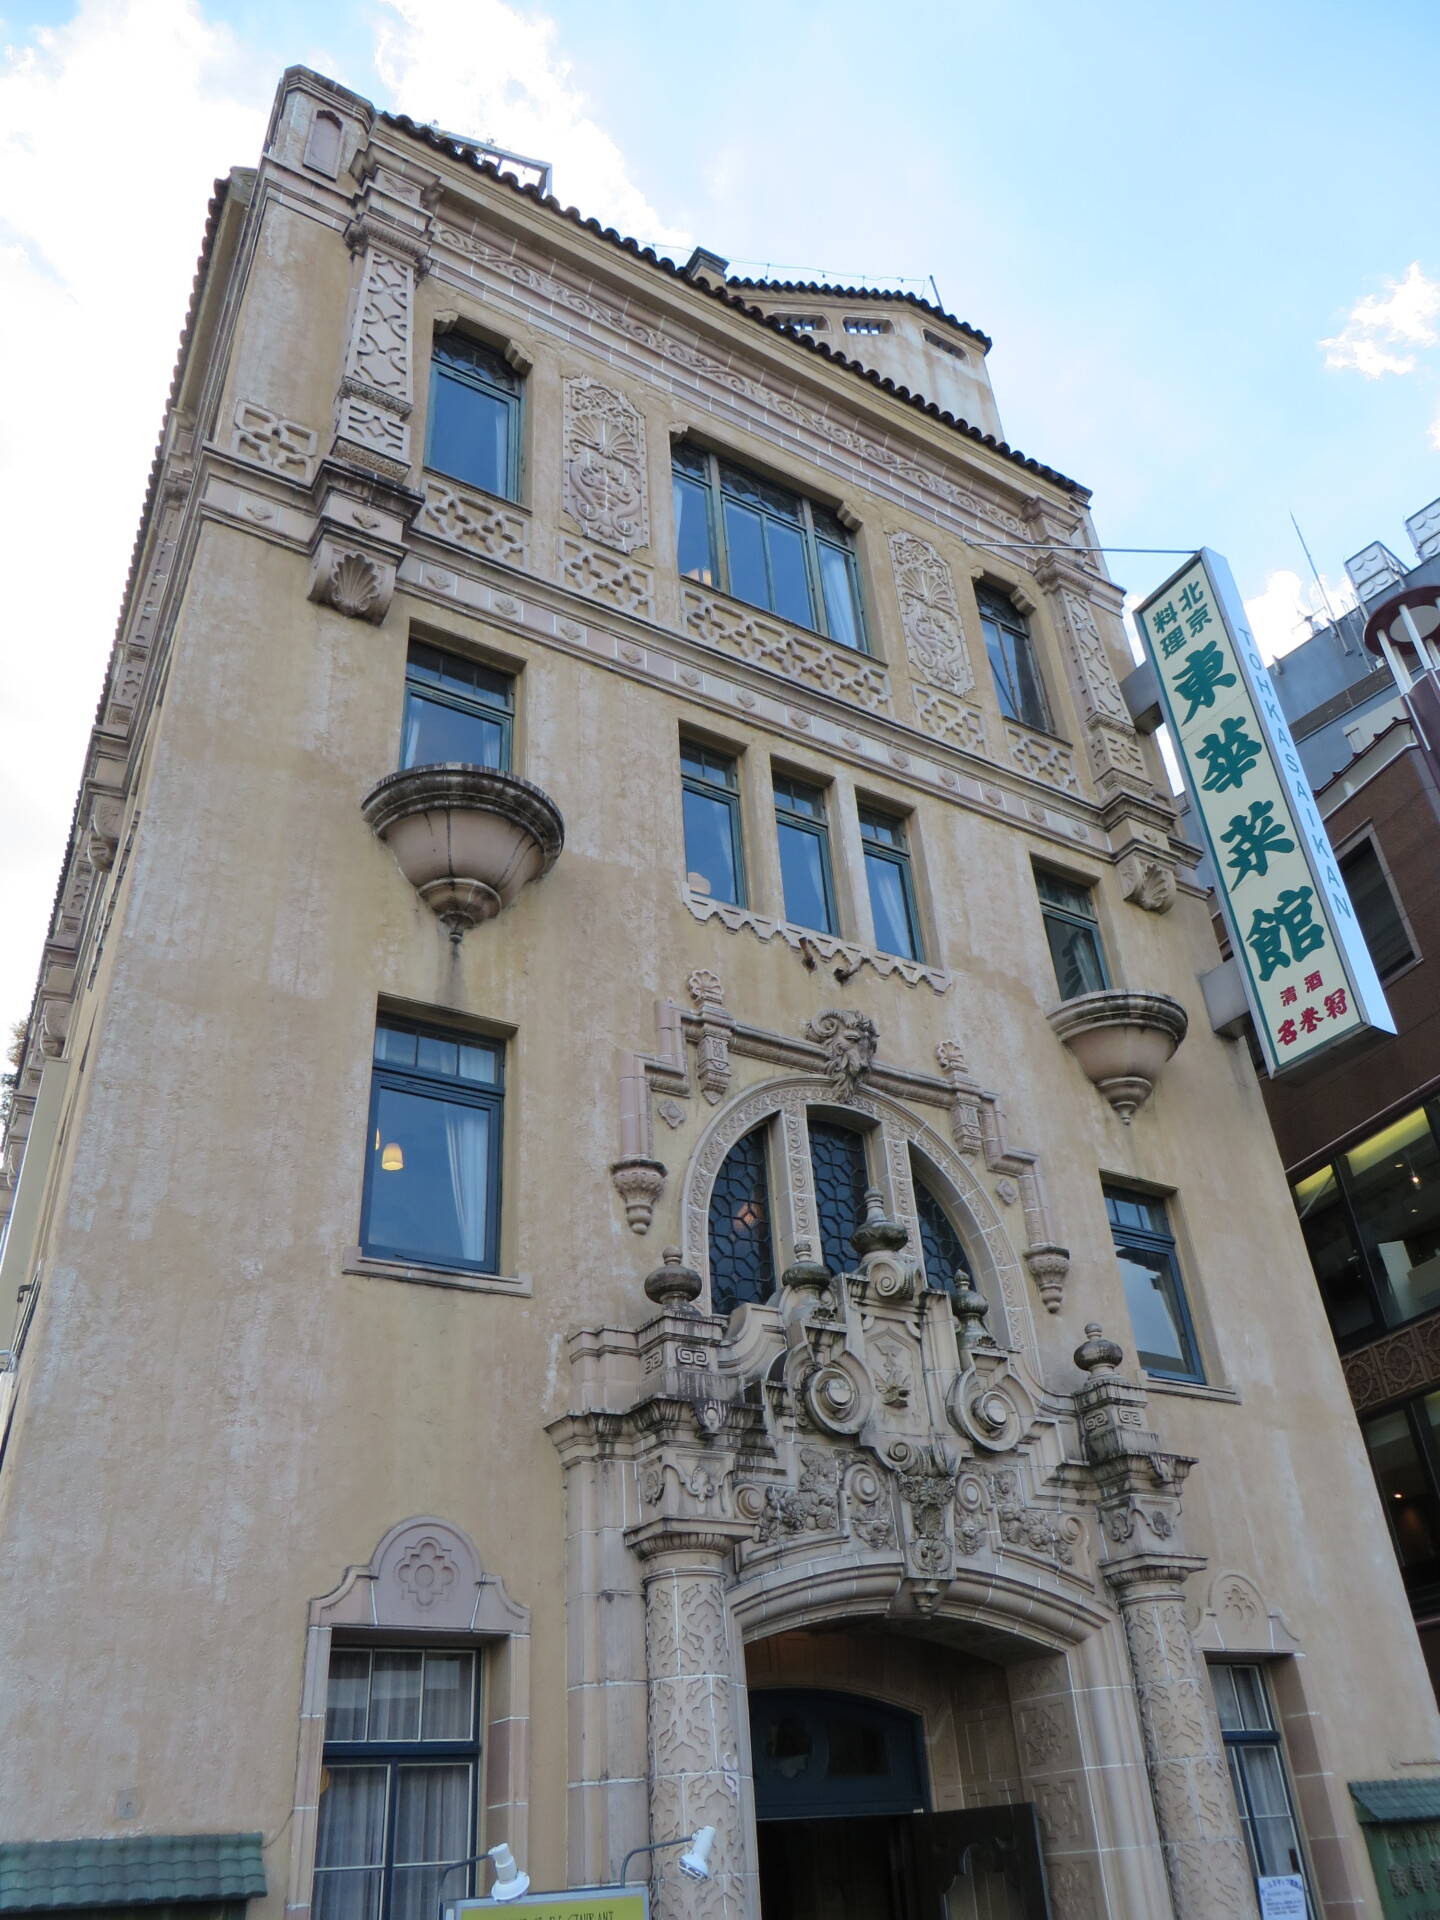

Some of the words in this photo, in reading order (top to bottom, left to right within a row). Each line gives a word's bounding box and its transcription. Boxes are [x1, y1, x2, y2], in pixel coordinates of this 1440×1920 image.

[1152, 601, 1187, 660] 料理
[1178, 580, 1212, 637] 北京
[1238, 627, 1352, 918] TOHKASAIKAN
[1172, 640, 1325, 982] 東華菜館
[1279, 969, 1323, 1007] 清酒
